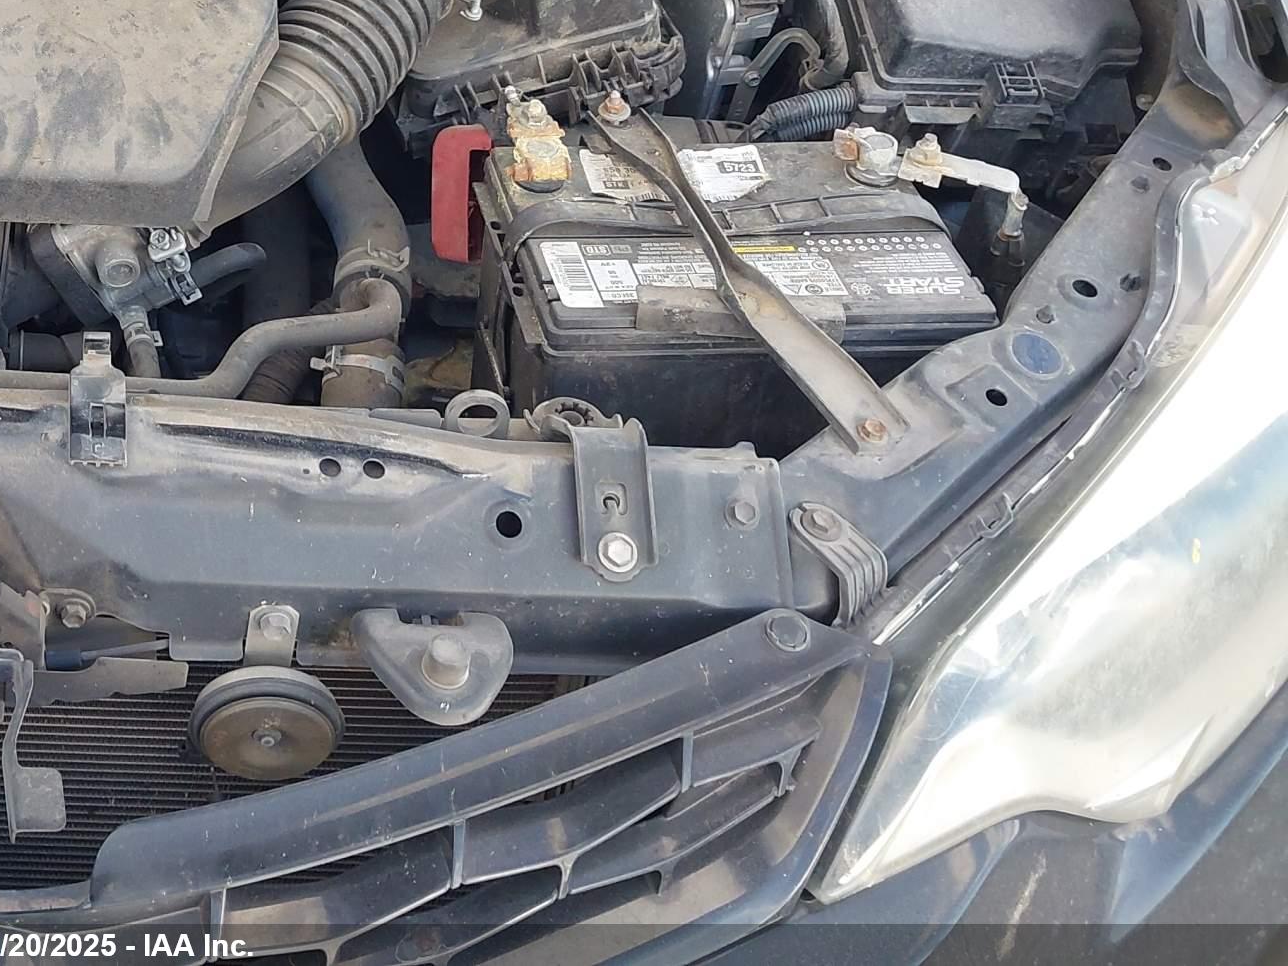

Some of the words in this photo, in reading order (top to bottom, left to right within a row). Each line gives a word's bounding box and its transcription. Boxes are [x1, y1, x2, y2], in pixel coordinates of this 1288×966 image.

[723, 162, 756, 173] 5723
[883, 276, 965, 287] START
[886, 285, 961, 295] SUPER
